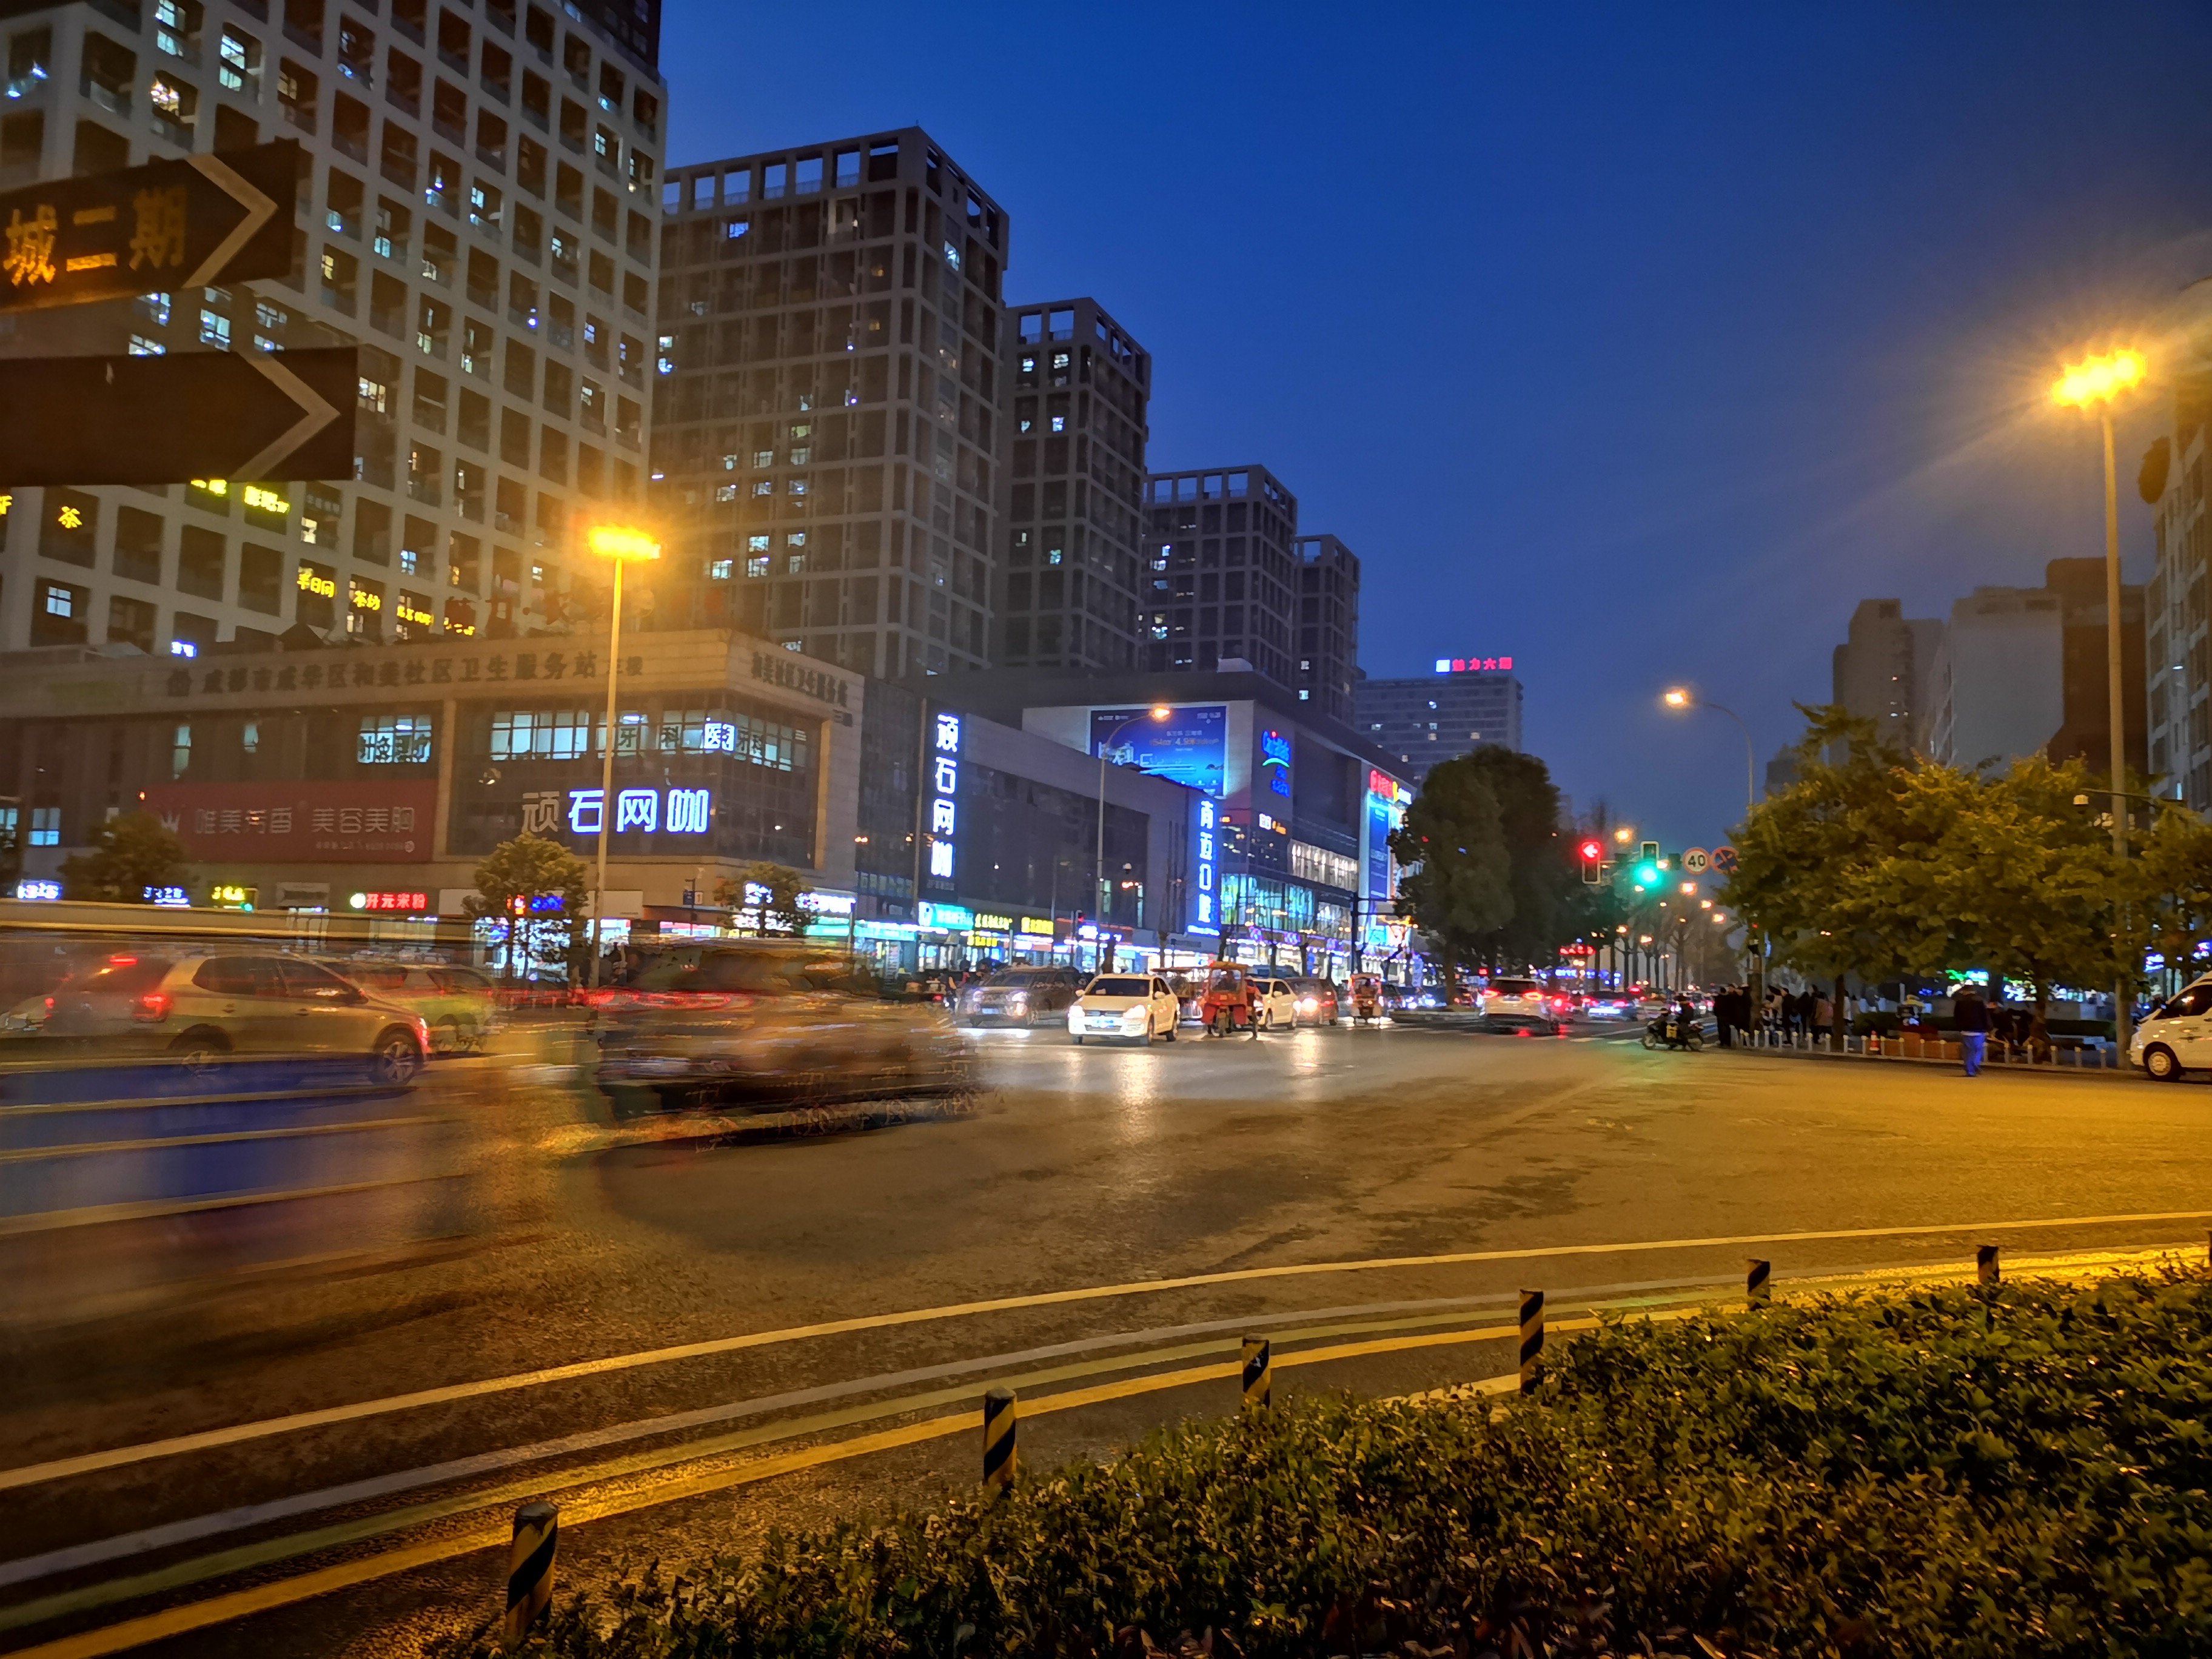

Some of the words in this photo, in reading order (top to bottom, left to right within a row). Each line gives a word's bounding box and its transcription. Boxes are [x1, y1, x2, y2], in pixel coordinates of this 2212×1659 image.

[3, 185, 187, 287] 城二期
[522, 789, 709, 834] 顽石网咖
[1687, 854, 1706, 868] 40
[366, 893, 426, 910] 开元米粉
